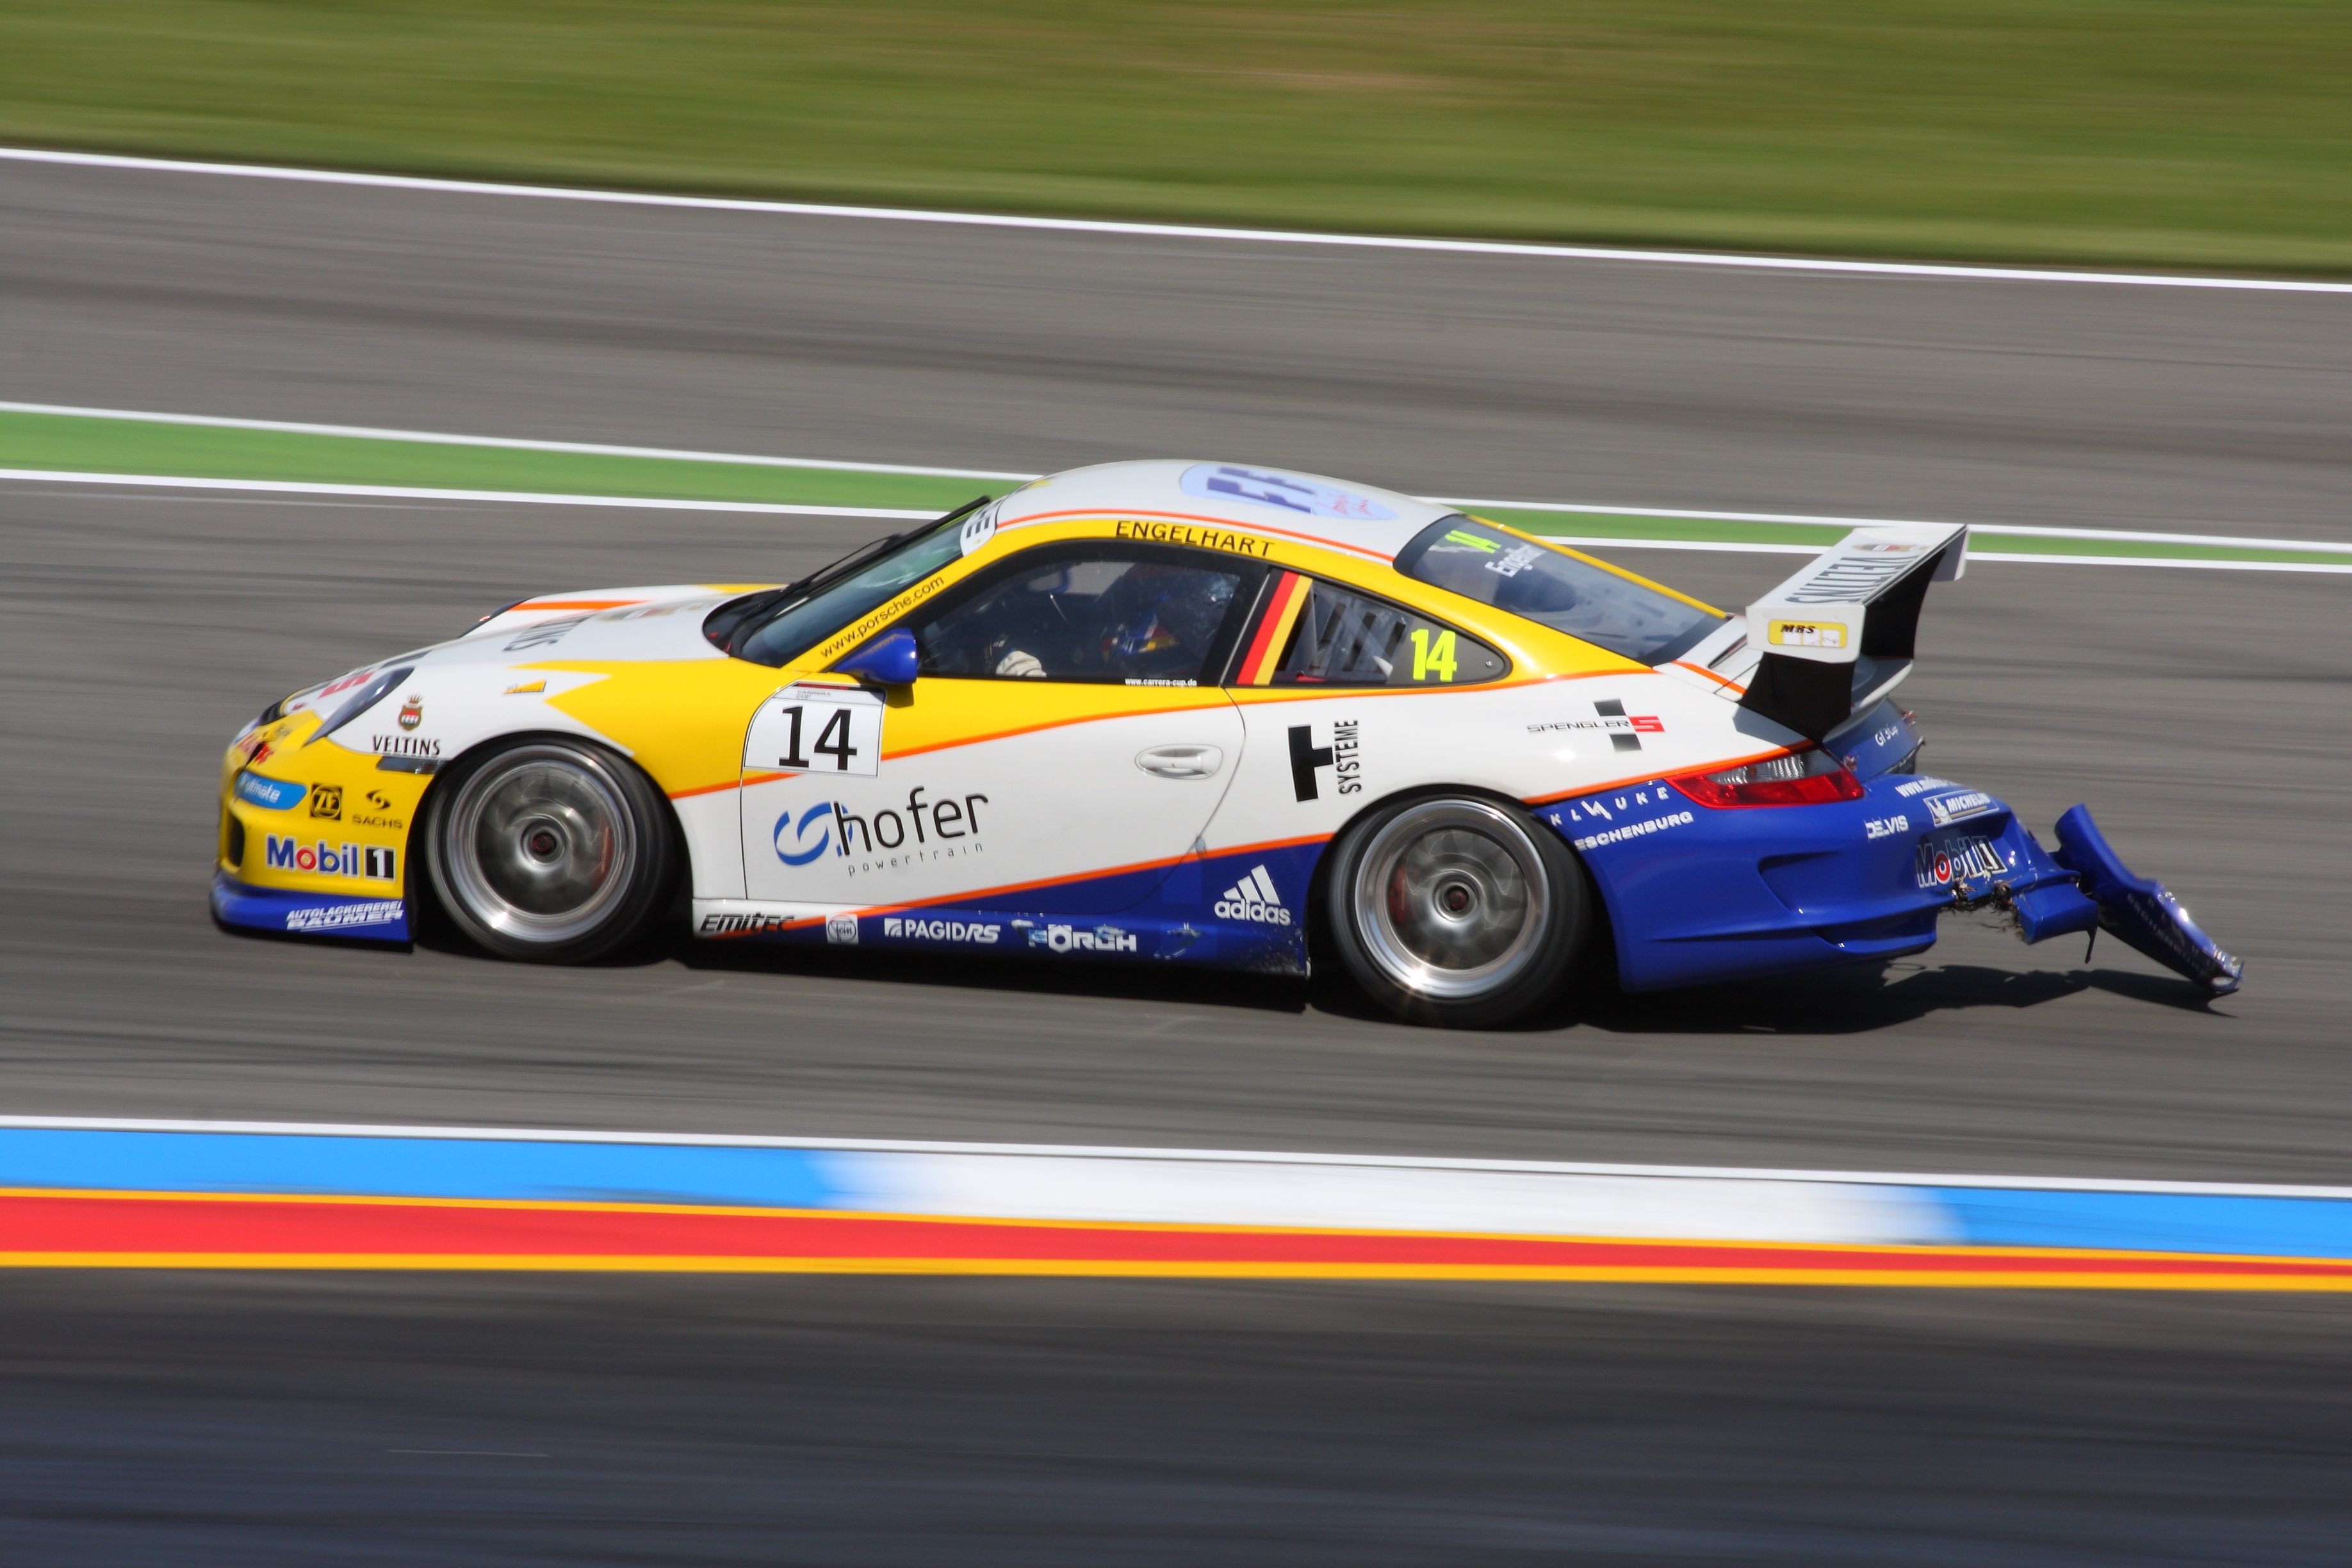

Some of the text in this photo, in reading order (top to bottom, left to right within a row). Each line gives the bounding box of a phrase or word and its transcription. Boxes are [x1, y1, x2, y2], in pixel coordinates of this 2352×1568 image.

[1115, 521, 1275, 557] ENGELHART
[821, 576, 944, 658] www.porsche.com
[1411, 628, 1457, 682] 14
[1125, 678, 1197, 689] www.carrera-cup.de
[779, 705, 858, 771] 14
[1527, 719, 1630, 733] SPENGLER
[372, 735, 441, 757] VELTINS
[1334, 719, 1362, 794] SYSTEME
[834, 785, 989, 856] hofer
[1945, 792, 1991, 813] MICHELIN
[352, 814, 404, 829] SACHS
[1573, 811, 1694, 852] ESCHENBURG
[265, 833, 389, 881] Mobil 1
[848, 842, 984, 878] powertrain
[1214, 898, 1291, 926] adidas
